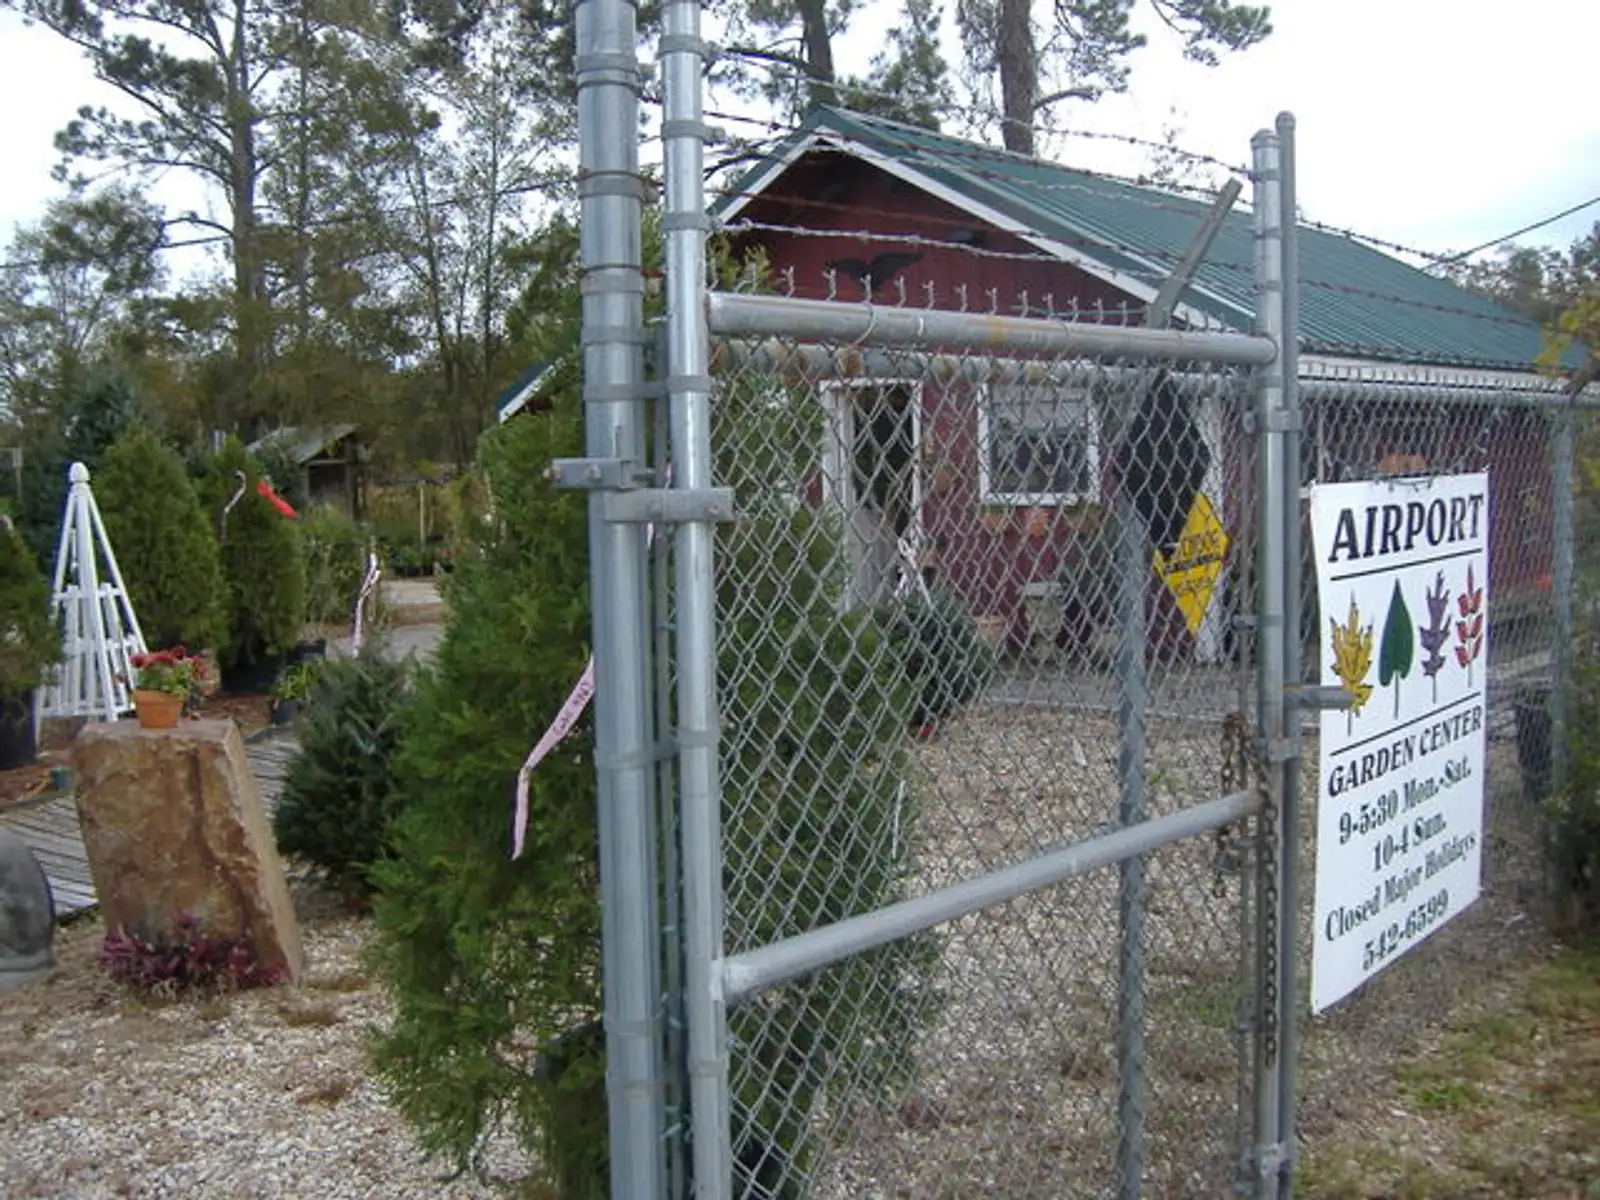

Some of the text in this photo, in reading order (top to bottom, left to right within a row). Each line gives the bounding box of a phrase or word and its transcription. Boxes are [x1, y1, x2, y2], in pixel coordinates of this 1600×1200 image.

[1328, 493, 1484, 563] AIRPORT
[1327, 704, 1482, 797] GARDEN CENTER
[1339, 788, 1399, 846] 9-5:30
[1373, 811, 1447, 872] 10-4 Sun.
[1325, 884, 1381, 942] Closed
[1383, 865, 1423, 908] Major
[1362, 887, 1449, 971] 542-6599
